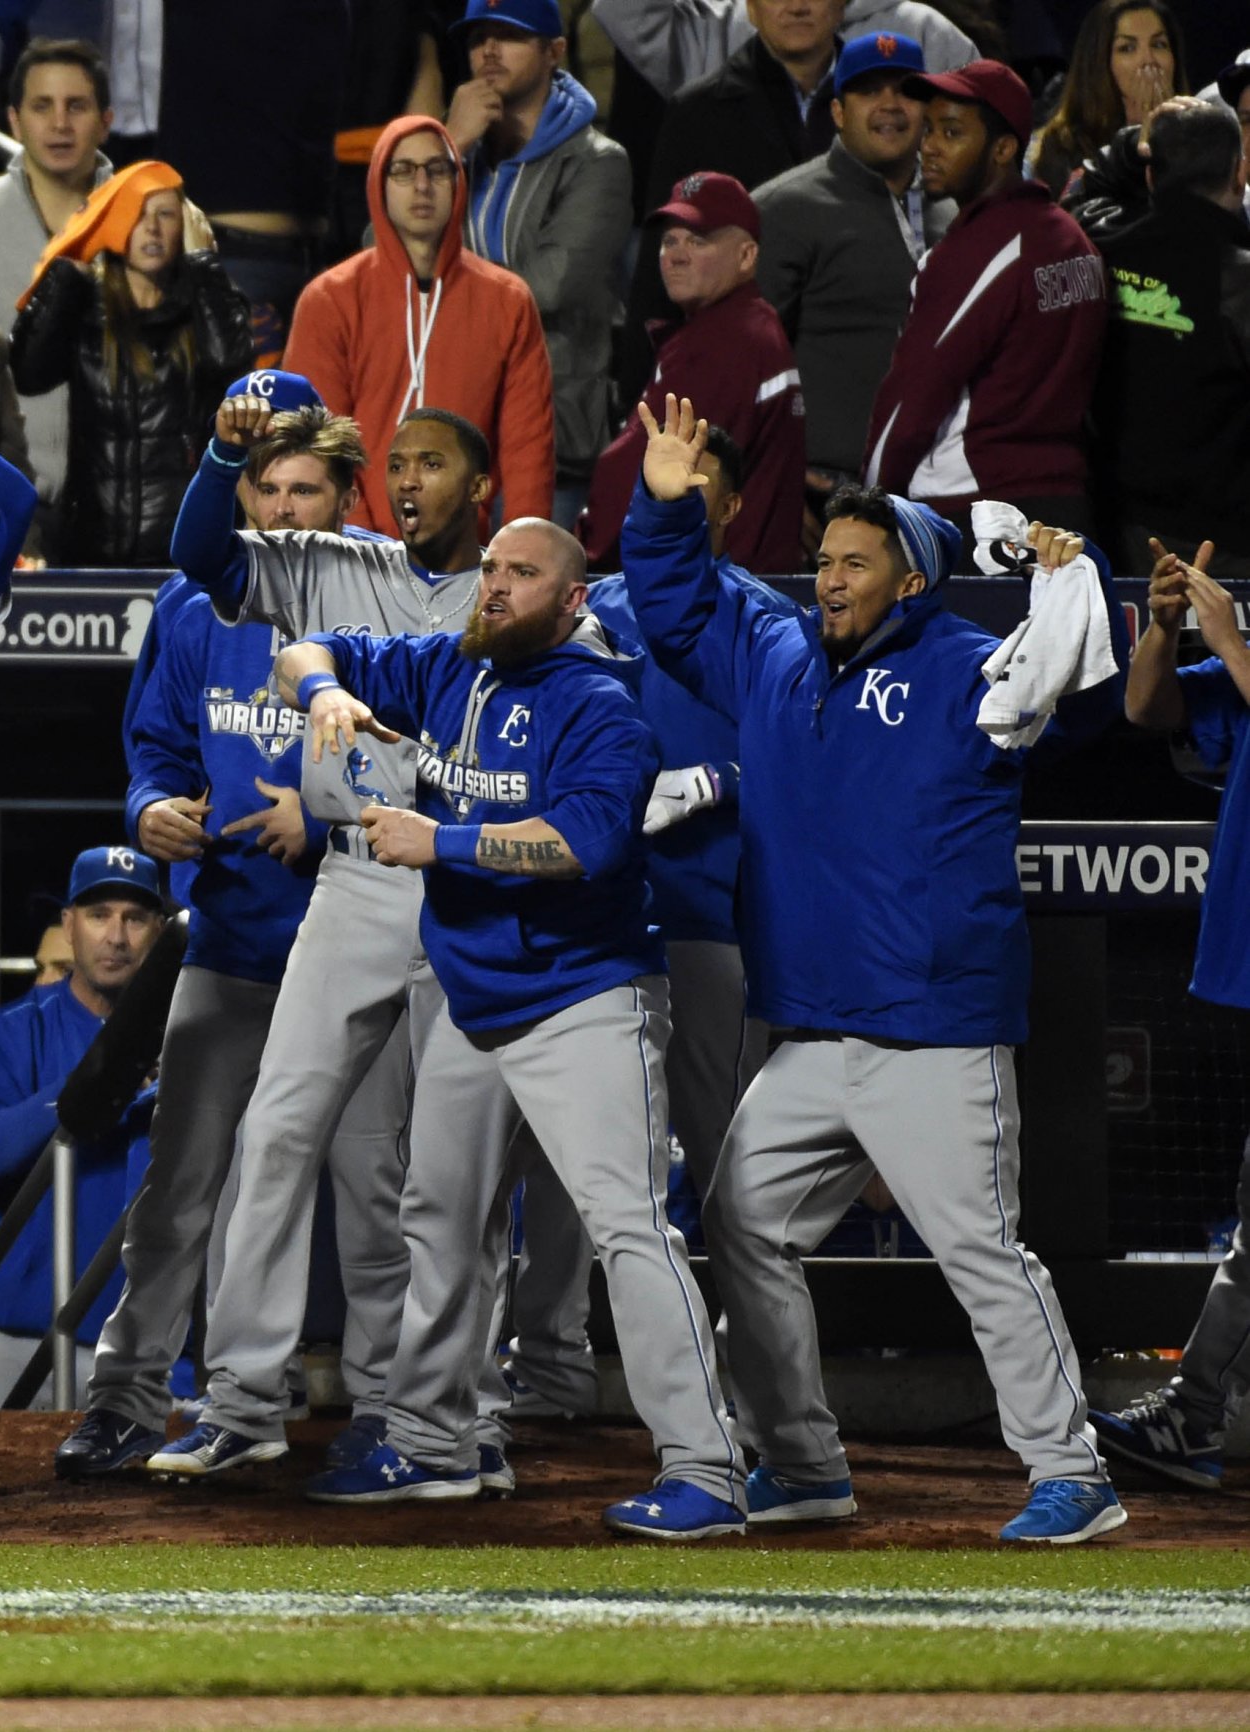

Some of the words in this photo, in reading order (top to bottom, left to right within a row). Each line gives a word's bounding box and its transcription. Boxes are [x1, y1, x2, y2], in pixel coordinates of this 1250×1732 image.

[246, 370, 276, 396] KC
[855, 668, 910, 726] KC
[464, 769, 528, 801] SERIES
[107, 847, 135, 870] KC
[480, 836, 507, 857] IN
[510, 840, 565, 860] THE
[1015, 845, 1210, 894] ETWOR
